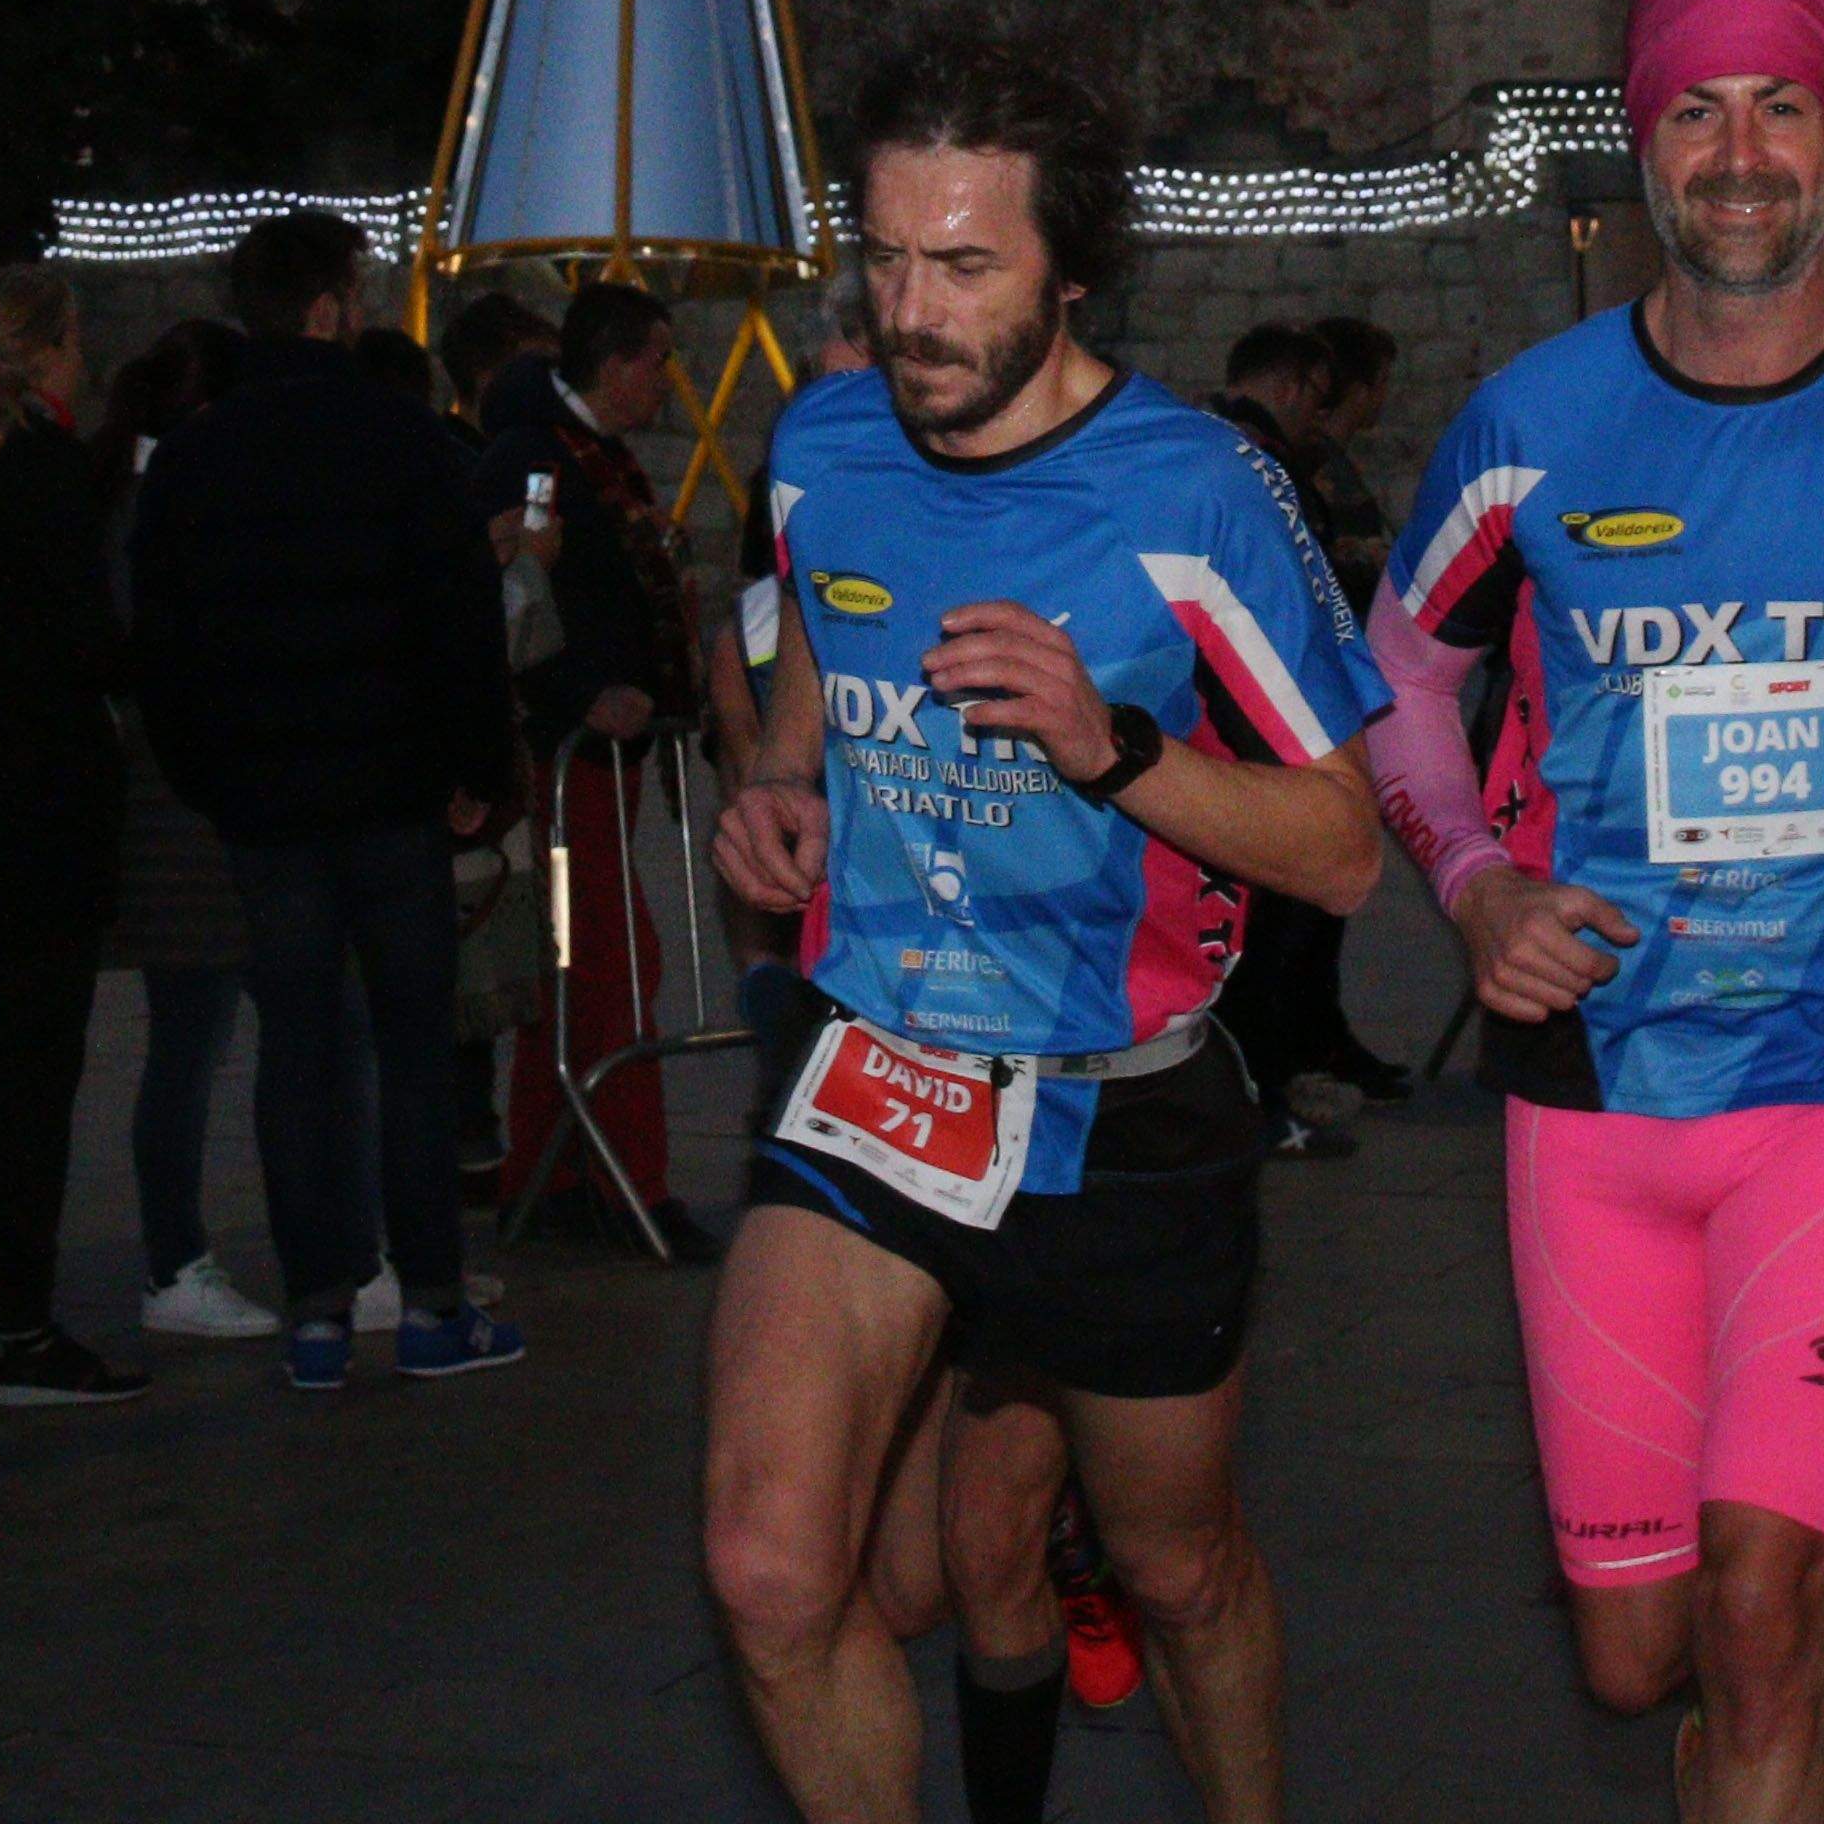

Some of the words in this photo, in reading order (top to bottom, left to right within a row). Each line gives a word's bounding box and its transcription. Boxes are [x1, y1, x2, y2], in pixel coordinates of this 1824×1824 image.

[1569, 600, 1745, 666] VDX
[1702, 716, 1820, 764] JOAN
[1719, 760, 1812, 805] 994
[862, 1043, 973, 1114] DAVID
[878, 1097, 935, 1149] 71
